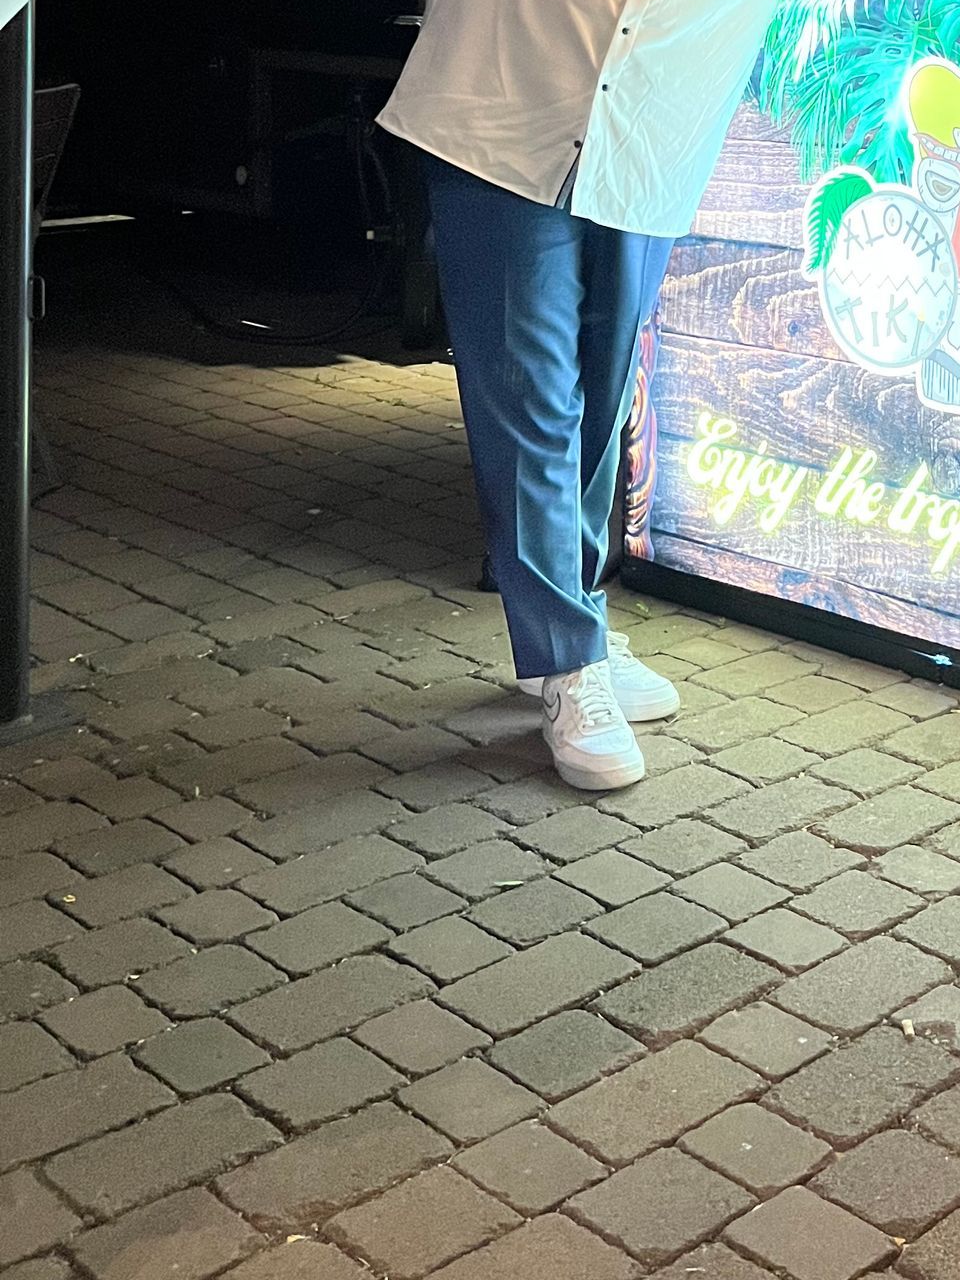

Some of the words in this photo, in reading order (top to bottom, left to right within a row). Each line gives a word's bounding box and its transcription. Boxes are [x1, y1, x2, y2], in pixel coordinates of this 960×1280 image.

[841, 204, 946, 272] ALOHA
[835, 294, 924, 357] TIKI
[687, 412, 808, 533] Enjoy
[814, 445, 887, 523] the
